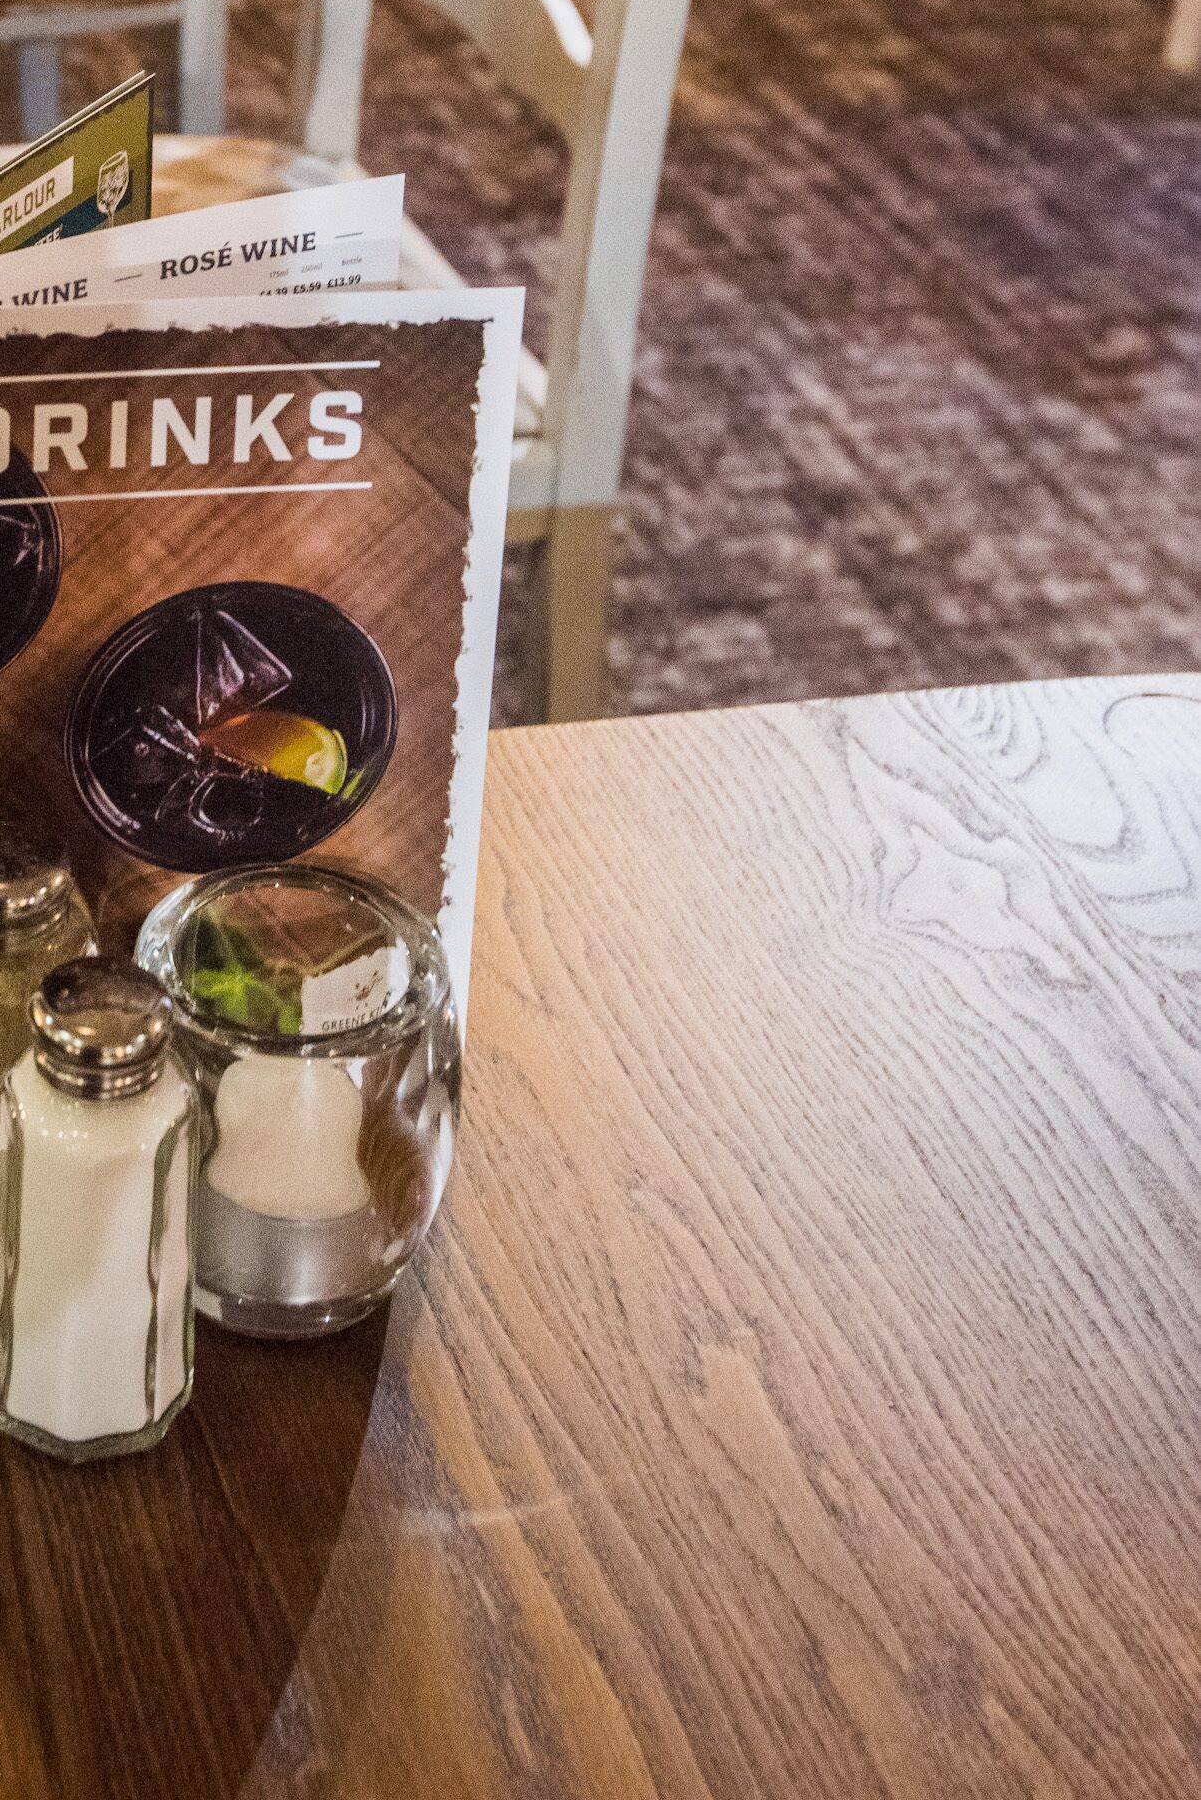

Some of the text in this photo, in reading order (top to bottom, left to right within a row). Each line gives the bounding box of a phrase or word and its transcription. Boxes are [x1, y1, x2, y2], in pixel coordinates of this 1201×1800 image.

[160, 231, 317, 280] ROSÉ WINE
[327, 274, 362, 289] £13.99
[321, 1011, 366, 1032] GREENE
